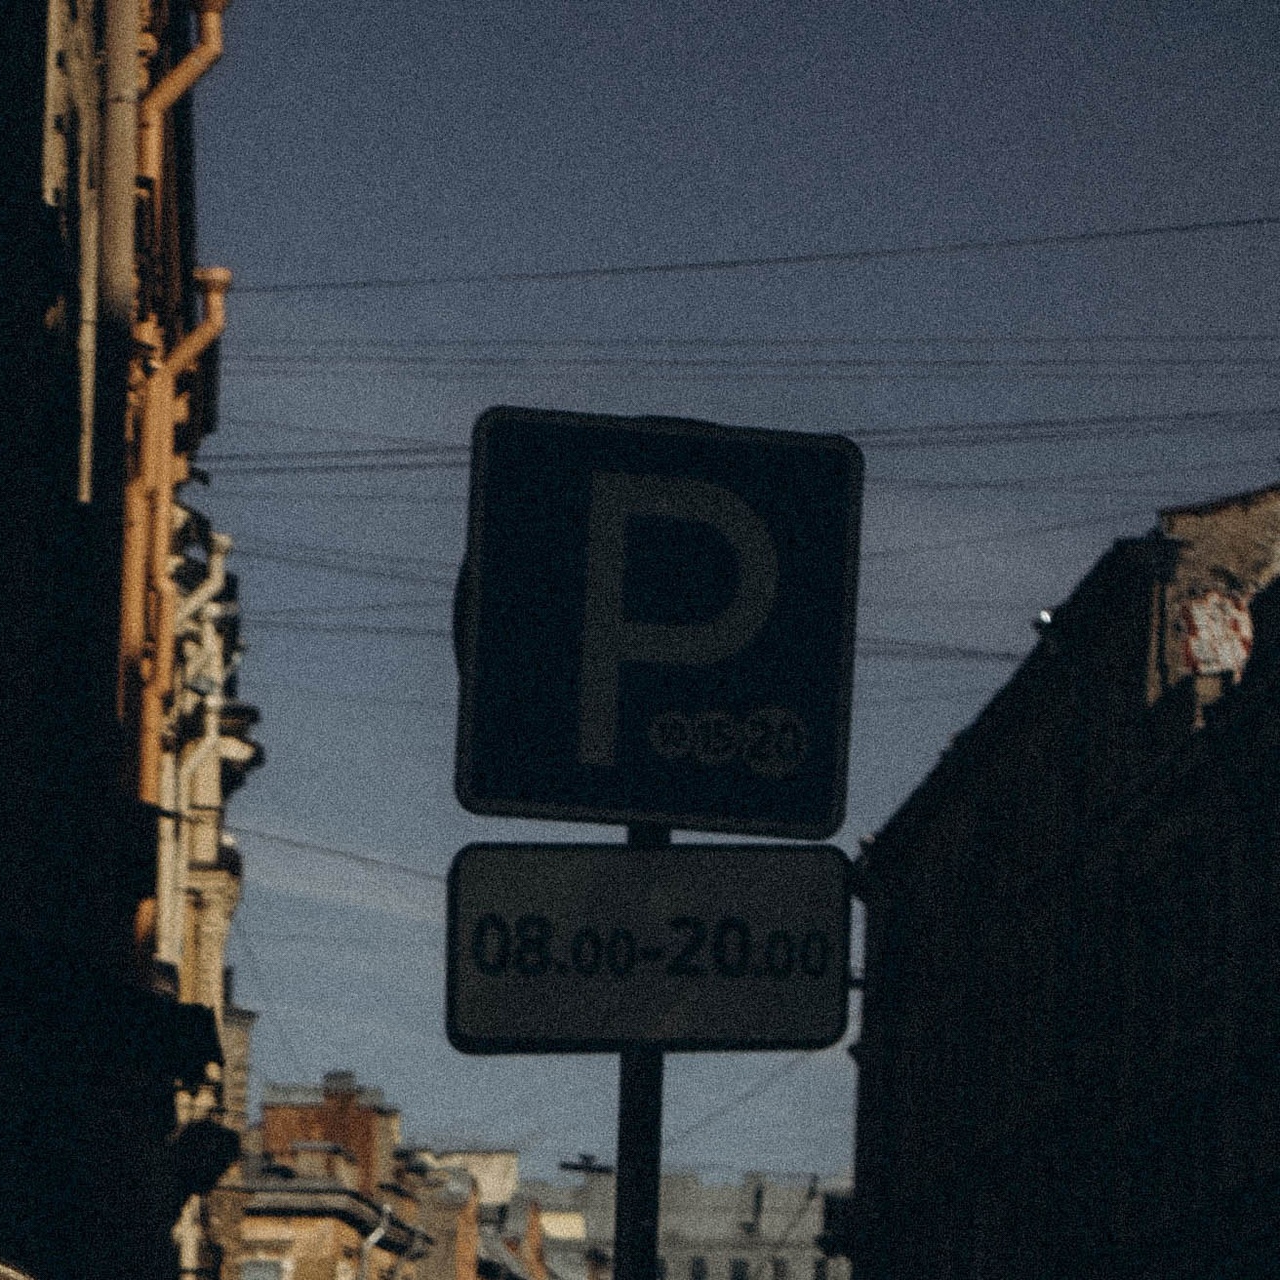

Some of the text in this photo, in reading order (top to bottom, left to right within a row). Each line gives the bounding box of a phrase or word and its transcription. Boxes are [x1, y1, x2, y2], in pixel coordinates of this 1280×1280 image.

[578, 469, 779, 766] P
[696, 718, 735, 757] 15
[748, 718, 805, 763] 20
[472, 913, 832, 979] 08.00-20.00
